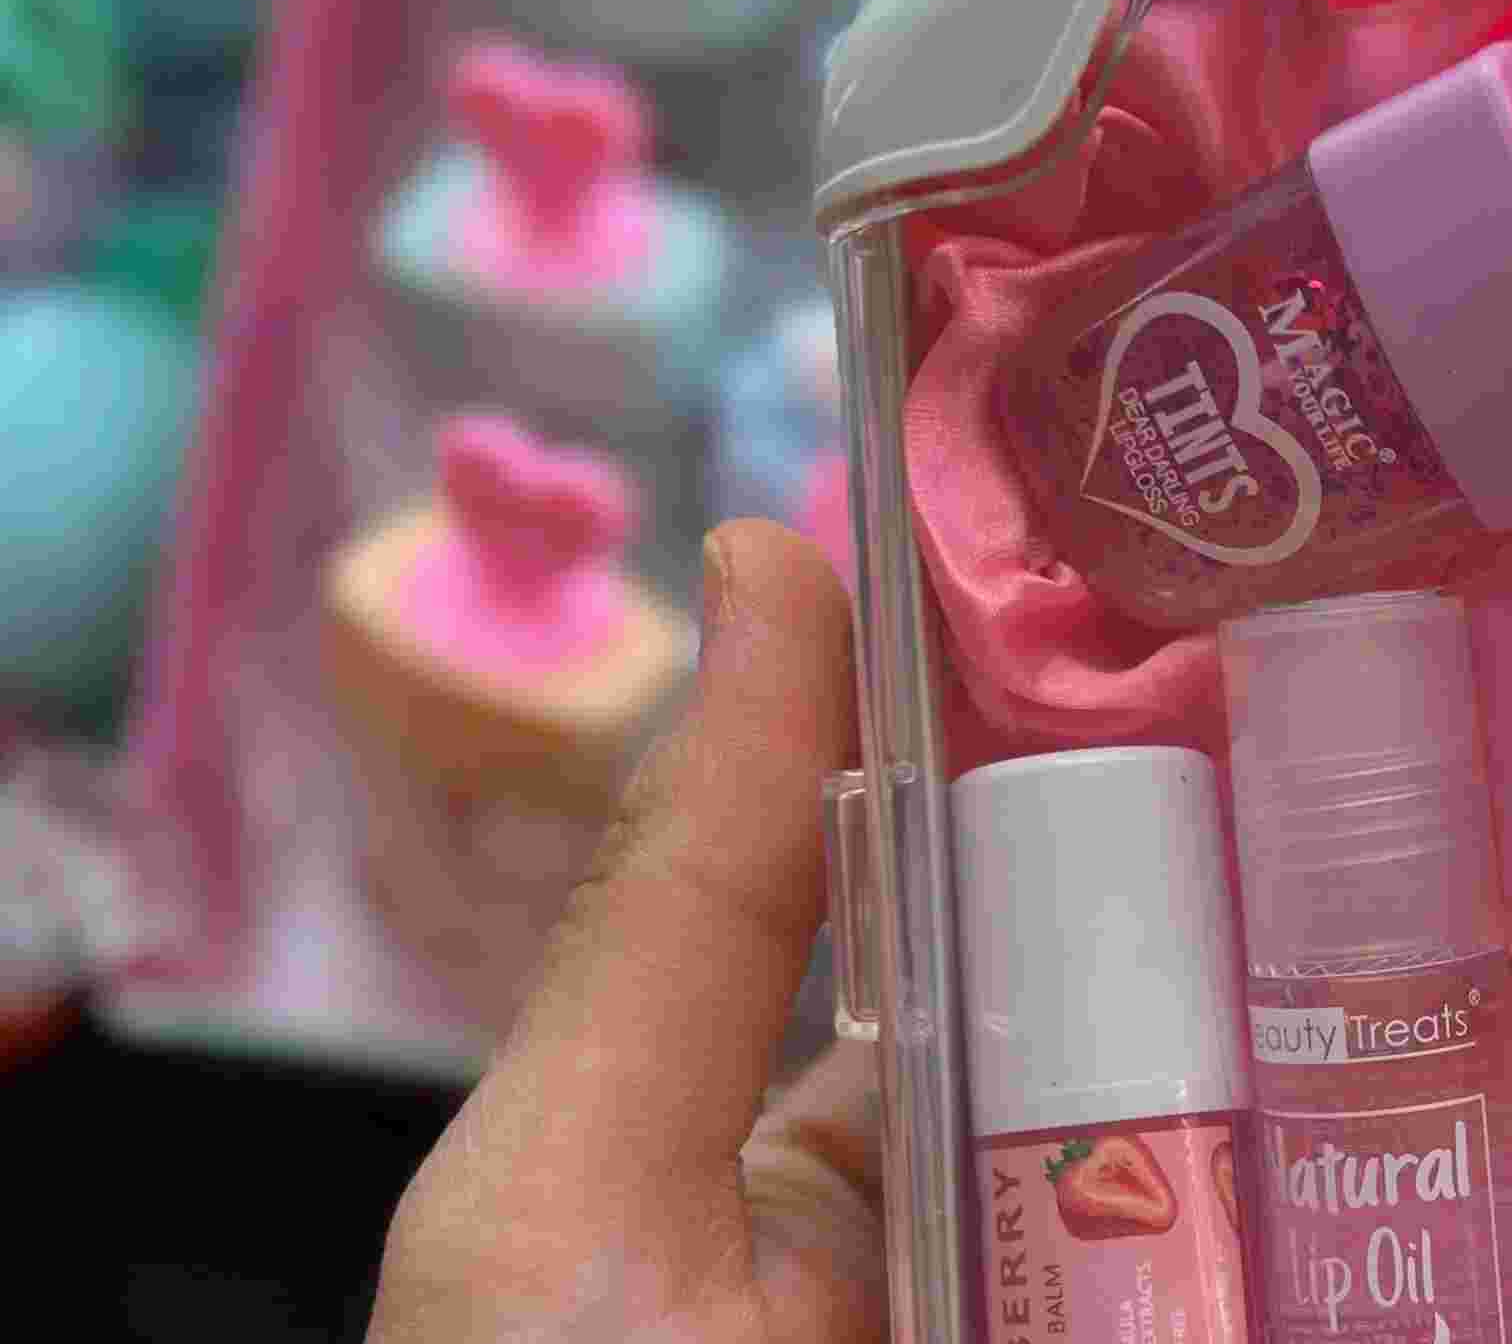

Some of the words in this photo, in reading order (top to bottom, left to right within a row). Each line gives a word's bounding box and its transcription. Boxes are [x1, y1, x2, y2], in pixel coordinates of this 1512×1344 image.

[1108, 418, 1169, 514] LIPGLOSS
[1119, 386, 1158, 447] DEAR
[1143, 443, 1201, 529] DARLING
[1144, 359, 1260, 513] TINTS
[1291, 365, 1328, 432] YOUR
[1315, 422, 1353, 472] LIFE
[1252, 1016, 1338, 1061] eauty
[1042, 1263, 1066, 1335] BALM
[1366, 1224, 1436, 1310] Oil
